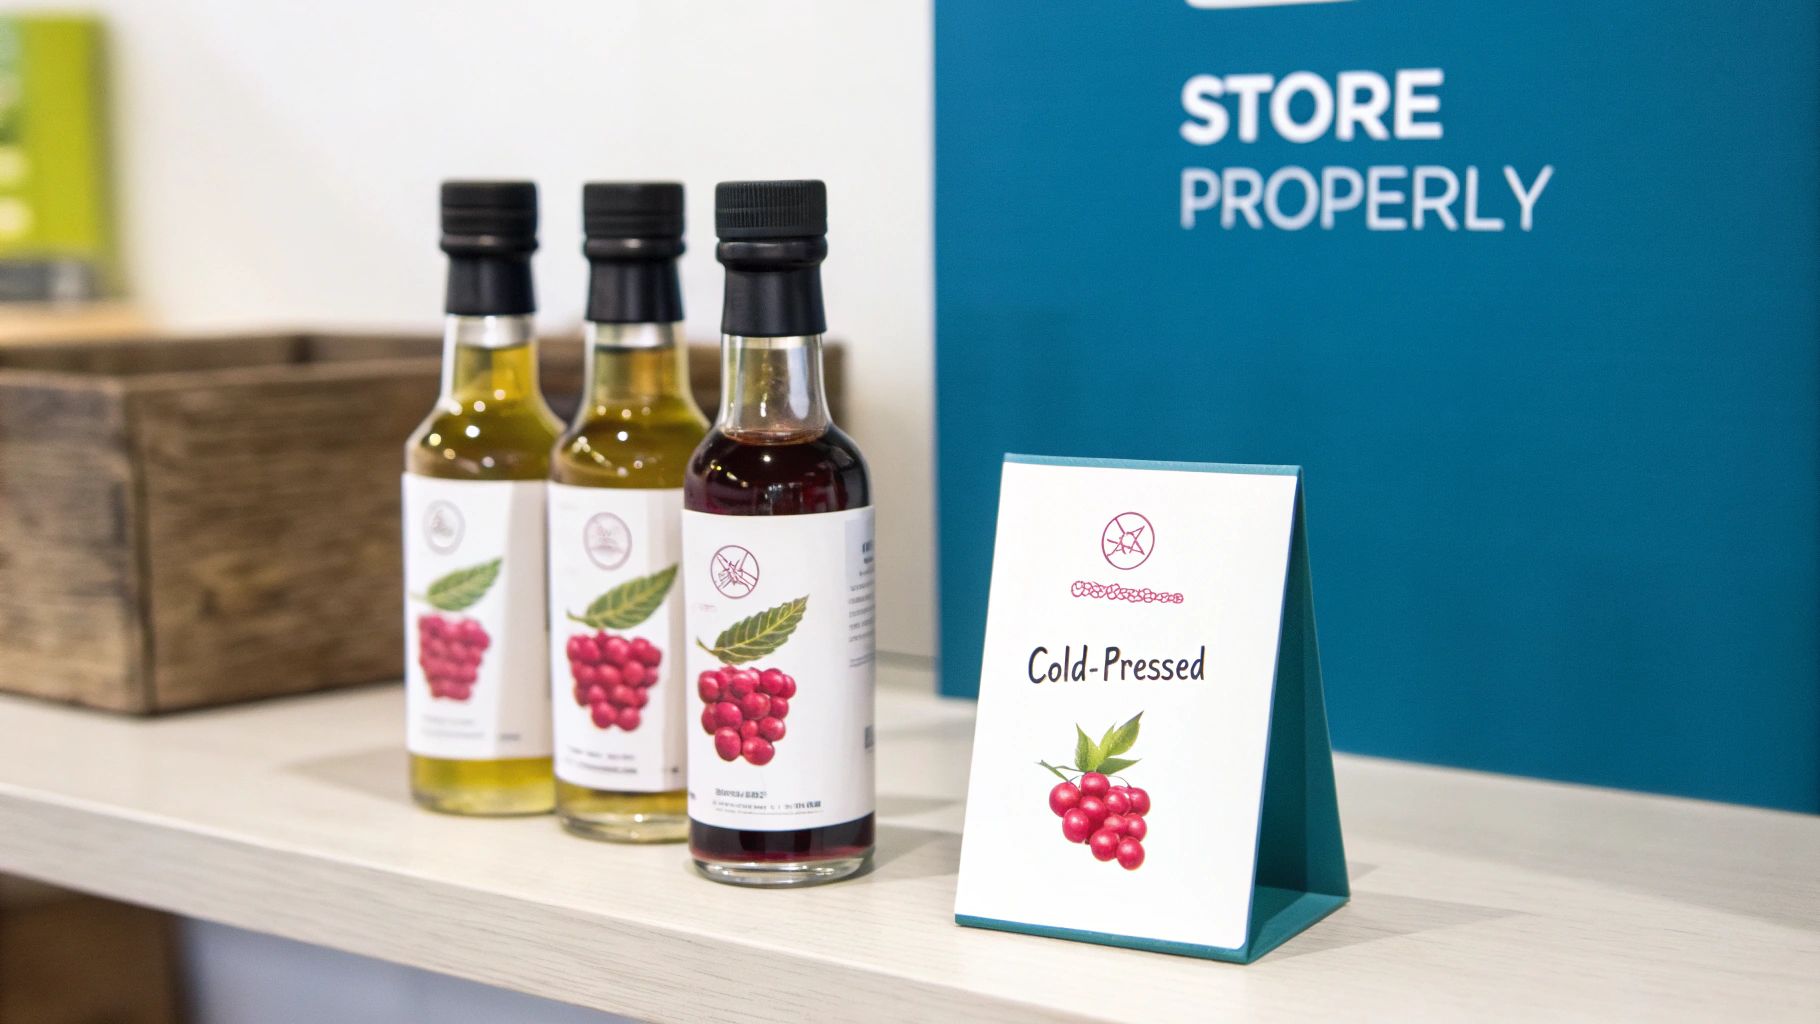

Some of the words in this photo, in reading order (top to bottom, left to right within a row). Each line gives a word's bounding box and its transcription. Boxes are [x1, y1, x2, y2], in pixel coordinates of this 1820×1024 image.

[1180, 69, 1444, 145] STORE
[1180, 165, 1555, 232] PROPERLY
[1027, 644, 1206, 683] Cold-Pressed
